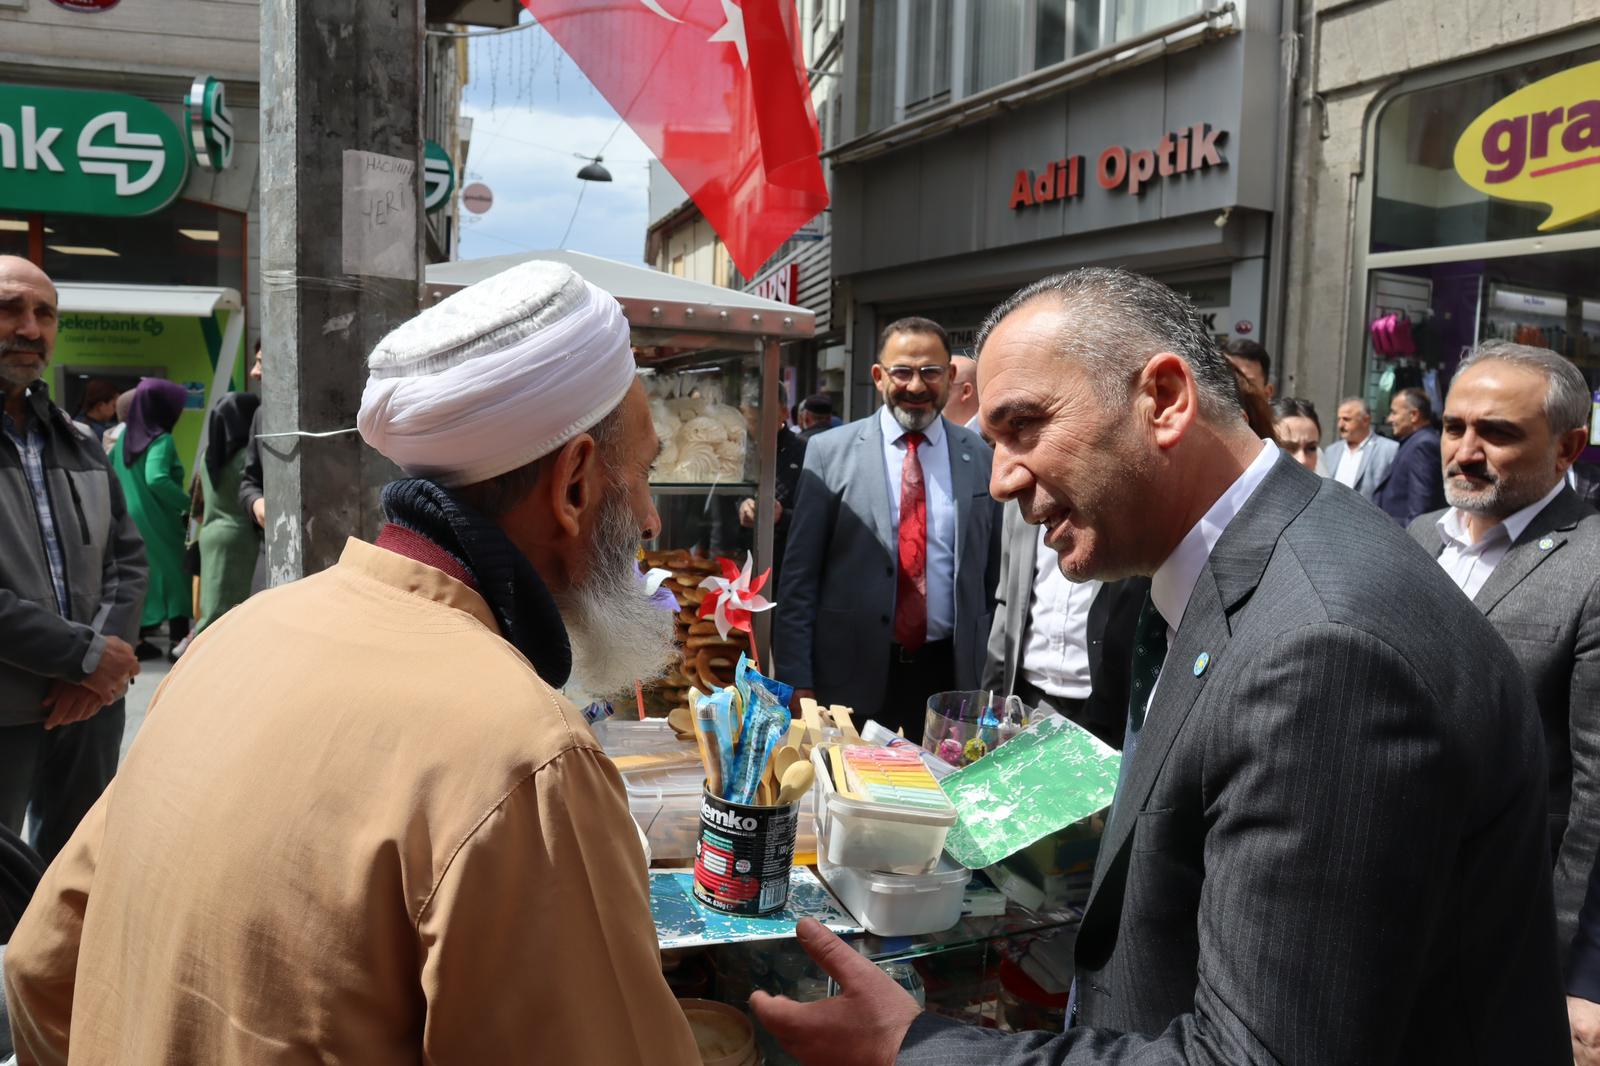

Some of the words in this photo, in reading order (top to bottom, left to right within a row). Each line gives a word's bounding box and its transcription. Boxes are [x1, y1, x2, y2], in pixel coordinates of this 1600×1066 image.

[1008, 154, 1084, 209] Adil
[1096, 122, 1225, 195] Optik
[1481, 99, 1600, 184] gra
